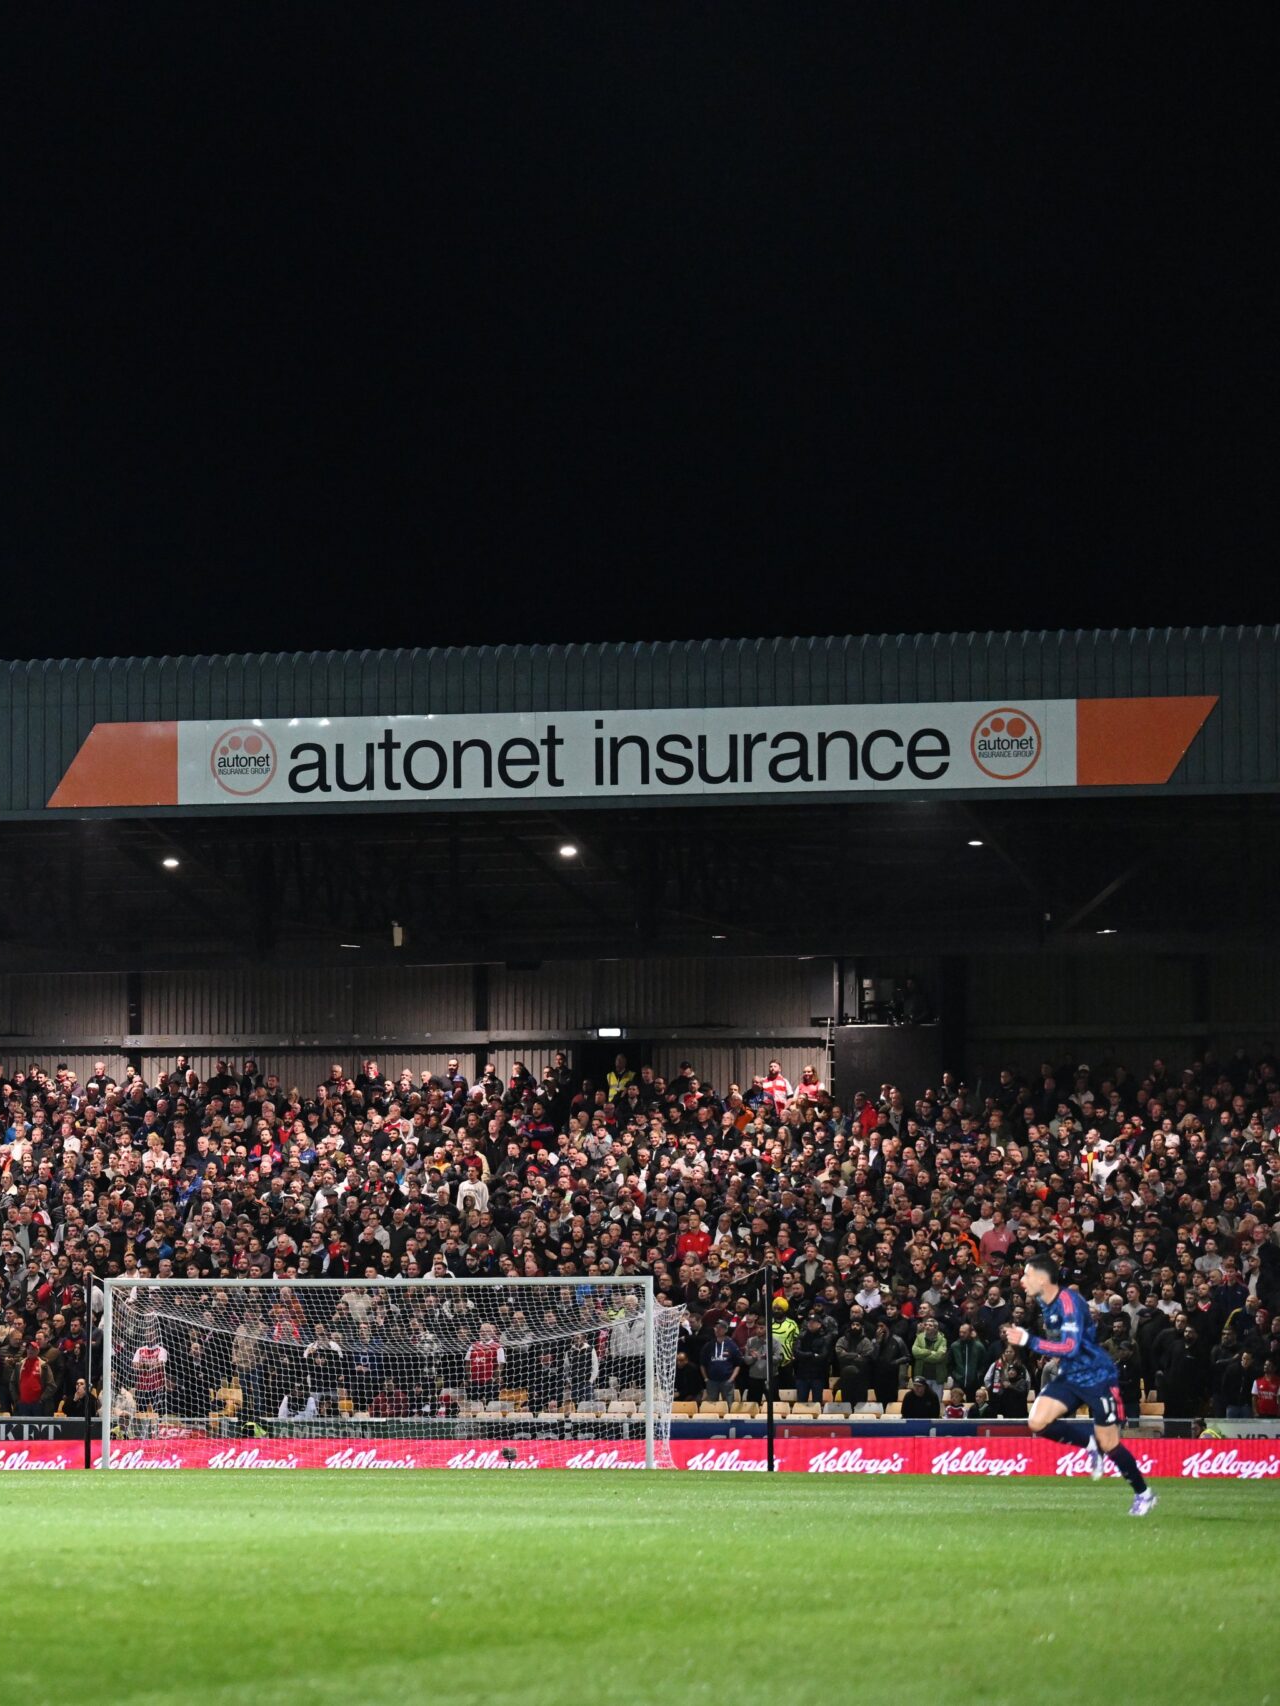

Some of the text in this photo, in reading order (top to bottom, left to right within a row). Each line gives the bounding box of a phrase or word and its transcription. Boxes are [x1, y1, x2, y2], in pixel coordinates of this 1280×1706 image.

[288, 719, 951, 793] autonet insurance
[978, 735, 1034, 750] autonet
[218, 754, 270, 768] autonet
[250, 767, 270, 775] GROUP
[808, 1447, 904, 1474] Kellogg's
[931, 1447, 1028, 1475] Kellogg's
[1181, 1448, 1280, 1478] Kellogg's
